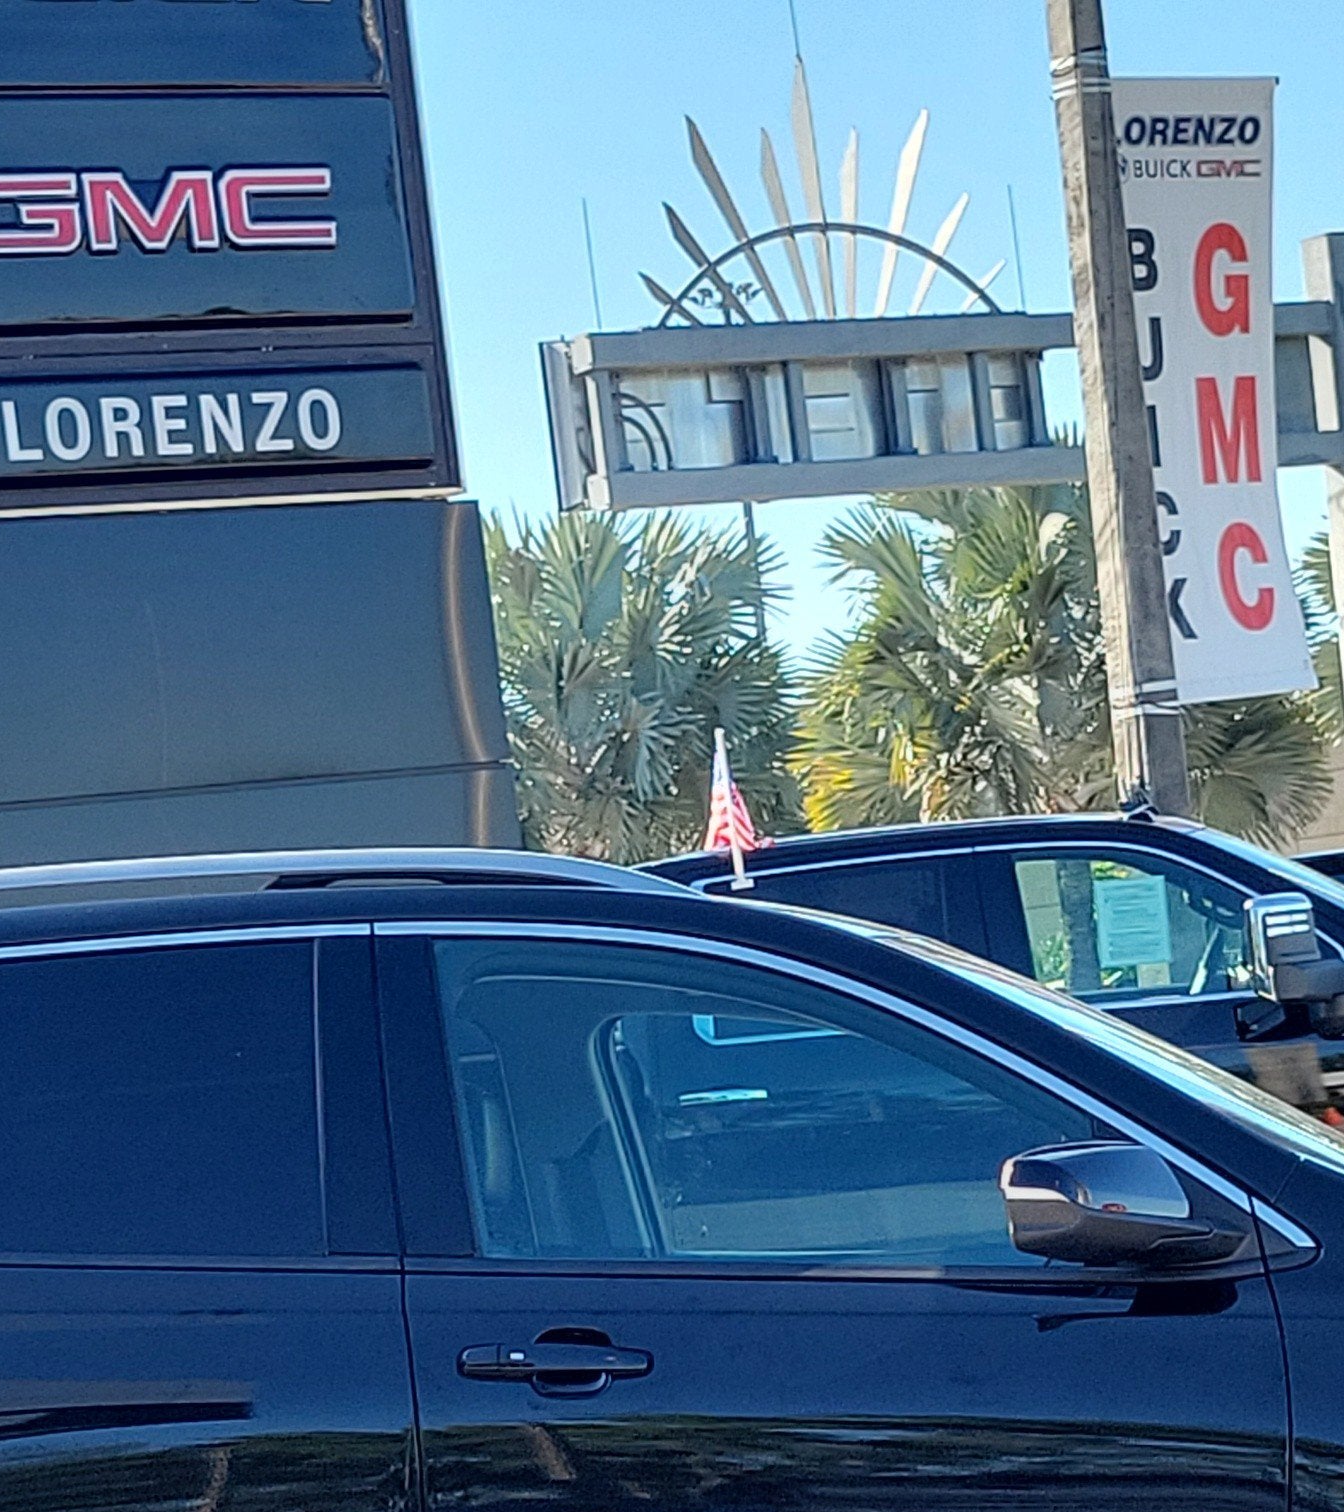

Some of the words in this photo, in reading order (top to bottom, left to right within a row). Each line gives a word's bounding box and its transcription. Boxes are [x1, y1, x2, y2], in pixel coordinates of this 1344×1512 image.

[1115, 116, 1261, 145] ORENZO
[1133, 160, 1192, 178] BUICK
[1196, 160, 1262, 177] GMC
[1, 388, 342, 463] LORENZO
[1194, 222, 1275, 631] GMC
